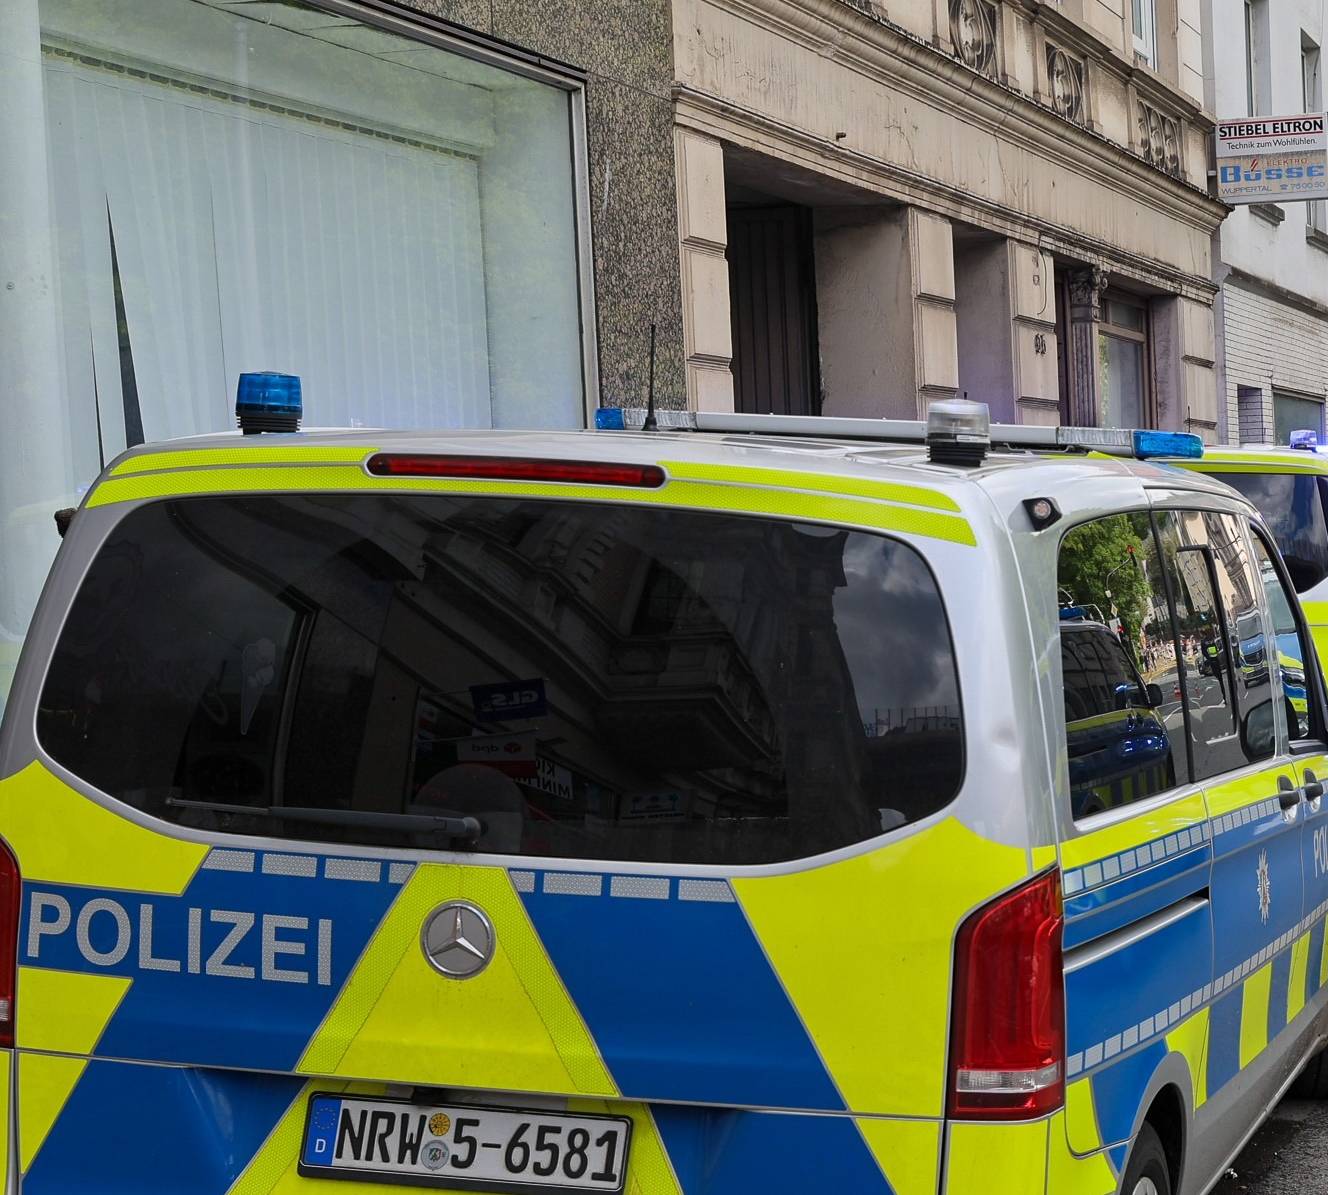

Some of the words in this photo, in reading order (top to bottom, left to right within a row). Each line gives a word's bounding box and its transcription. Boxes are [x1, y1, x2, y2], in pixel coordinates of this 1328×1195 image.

[1219, 124, 1269, 137] STIEBEL
[1272, 120, 1323, 133] ELTRON
[1227, 142, 1254, 150] Technik
[1273, 138, 1317, 147] Wohlfühlen.
[1221, 185, 1272, 194] WUPPERTAL
[26, 891, 332, 986] POLIZEI
[315, 1139, 326, 1153] D
[335, 1108, 427, 1166] NRW
[450, 1118, 618, 1183] 5-6581
